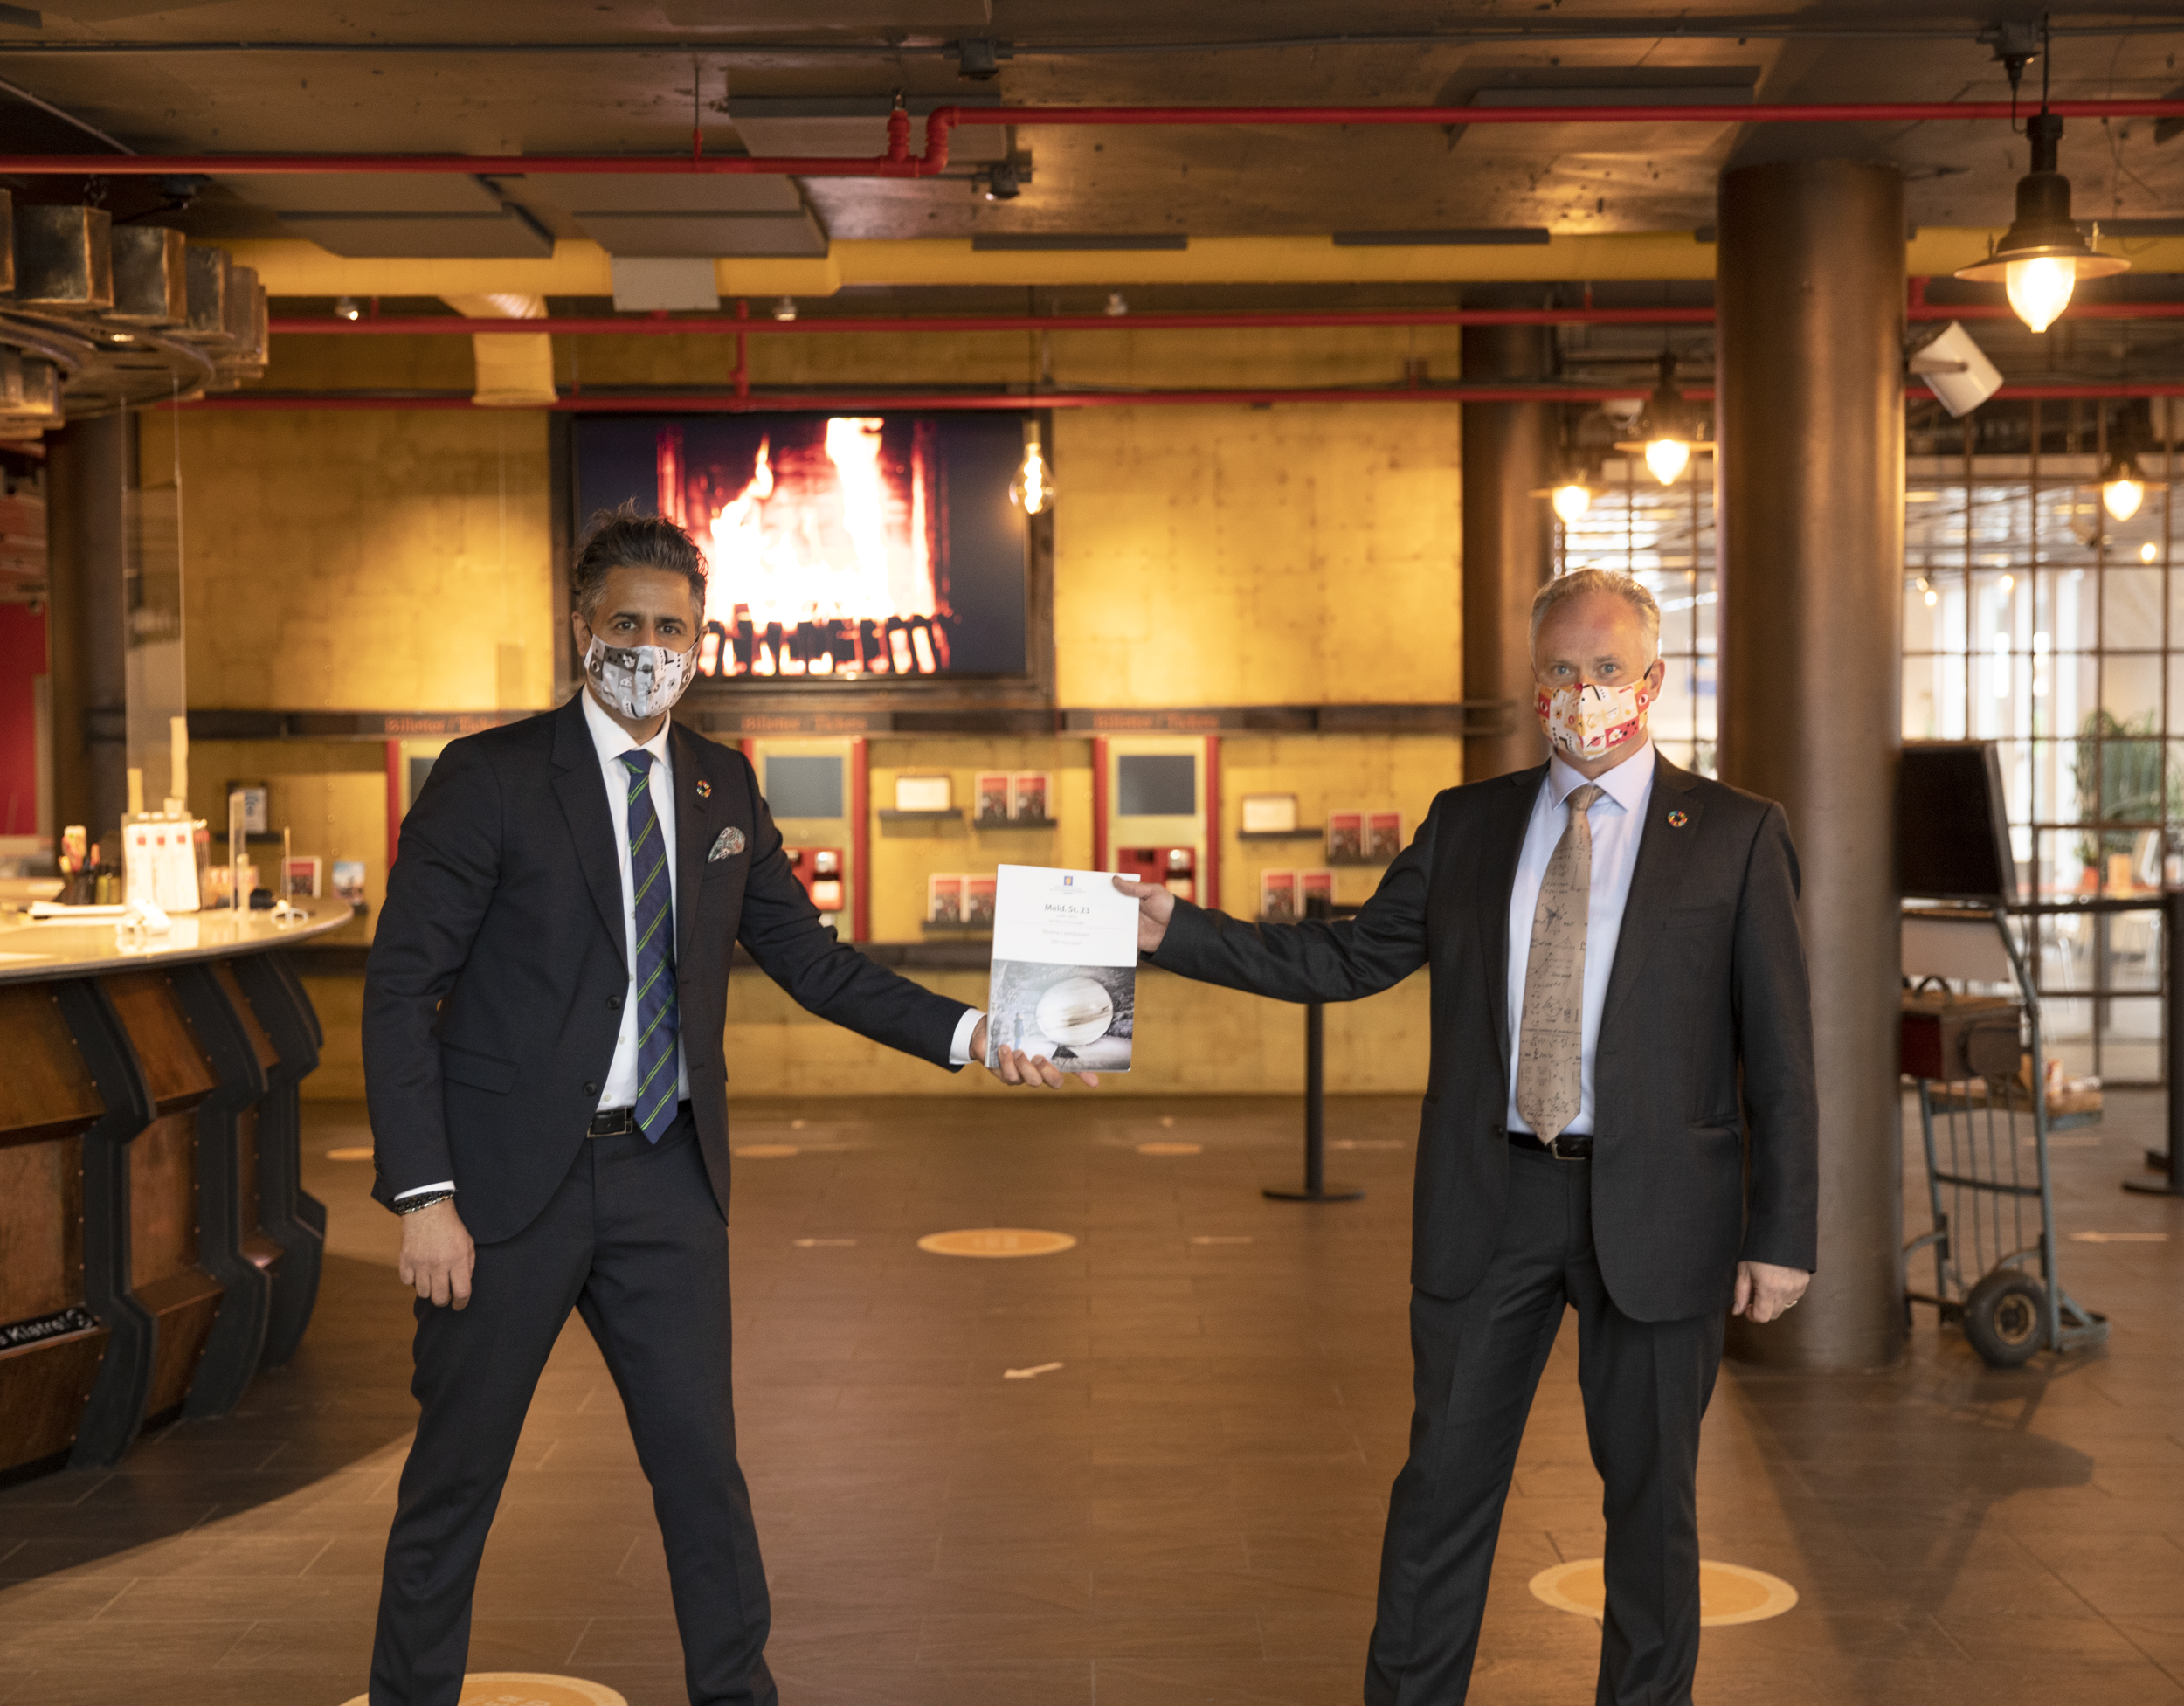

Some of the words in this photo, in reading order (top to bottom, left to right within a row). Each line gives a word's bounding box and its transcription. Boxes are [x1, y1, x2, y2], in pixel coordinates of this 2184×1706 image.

[1044, 903, 1068, 913] Meld.
[1068, 905, 1079, 914] St.
[1080, 906, 1090, 915] 23
